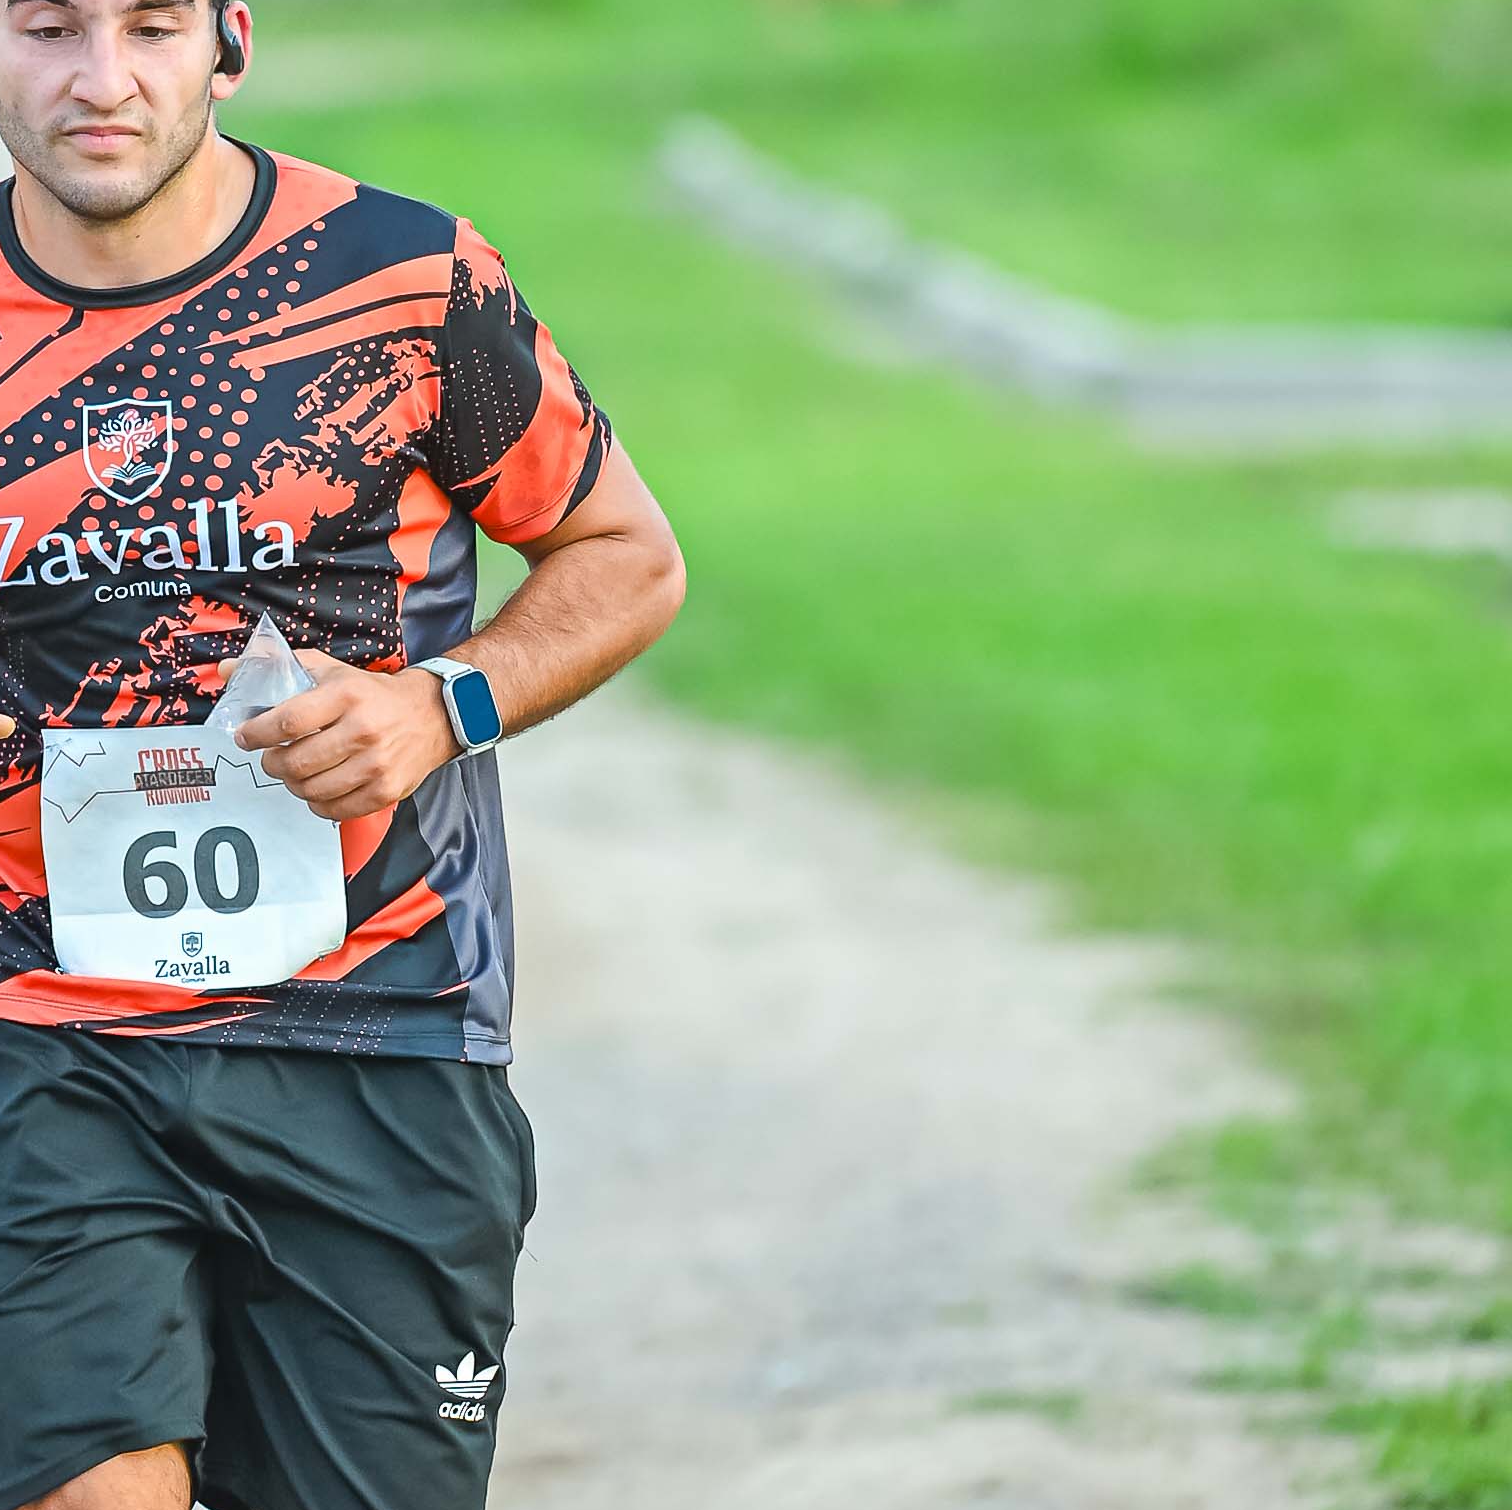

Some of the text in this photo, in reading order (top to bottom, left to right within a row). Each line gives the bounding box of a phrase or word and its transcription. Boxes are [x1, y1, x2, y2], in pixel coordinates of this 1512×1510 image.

[94, 578, 192, 604] Comuna
[137, 747, 205, 772] CROSS
[146, 786, 211, 806] RUNNING
[122, 825, 260, 919] 60
[154, 955, 231, 978] Zavalla
